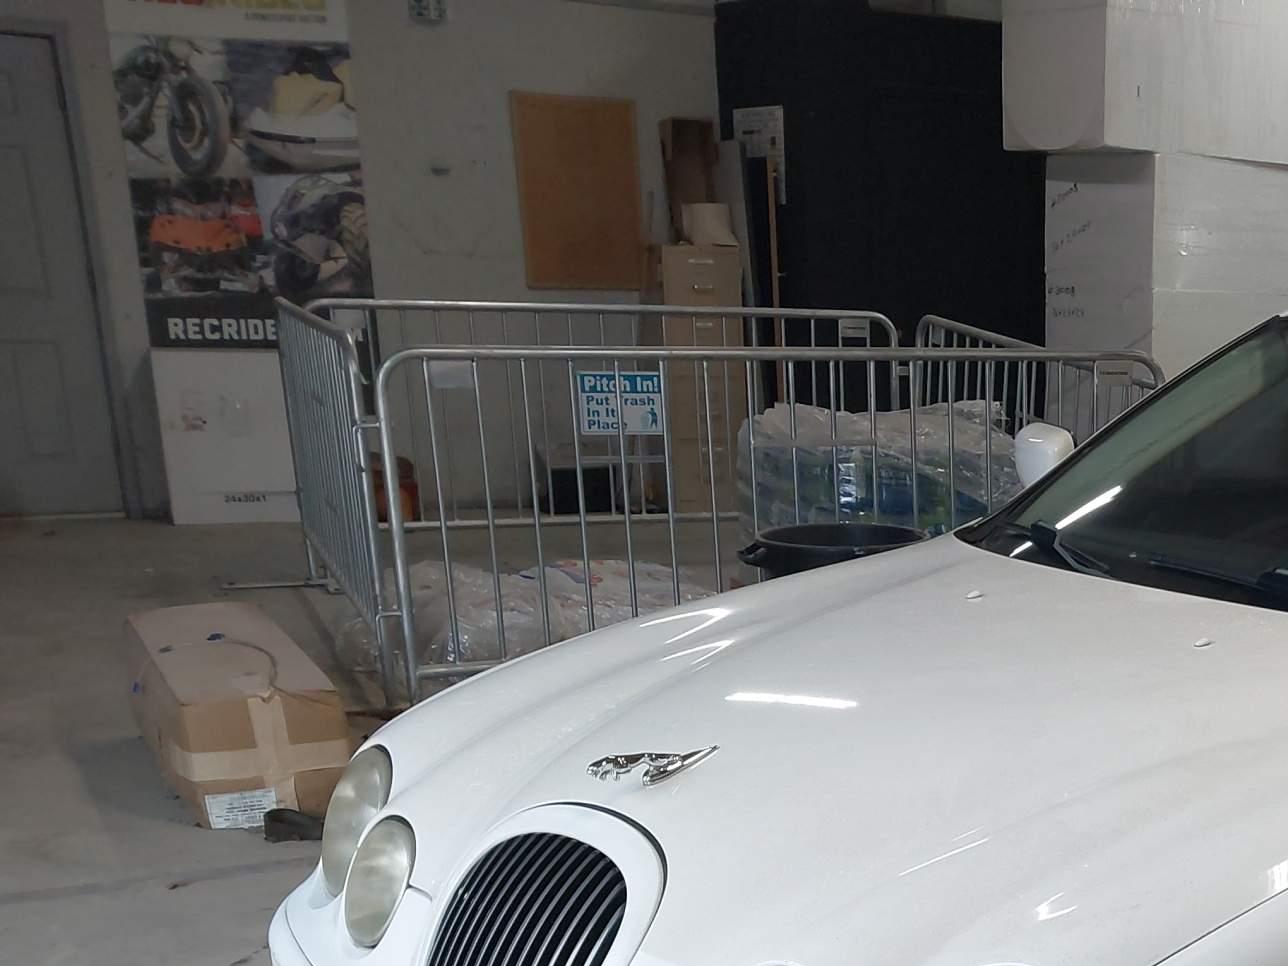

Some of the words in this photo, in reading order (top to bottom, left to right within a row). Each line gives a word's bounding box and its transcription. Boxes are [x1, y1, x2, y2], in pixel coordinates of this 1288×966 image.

[168, 317, 278, 340] RECRIDE
[583, 375, 630, 392] Pitch
[636, 376, 659, 392] In!
[586, 395, 611, 406] Put
[614, 395, 655, 406] rash
[587, 408, 600, 417] In
